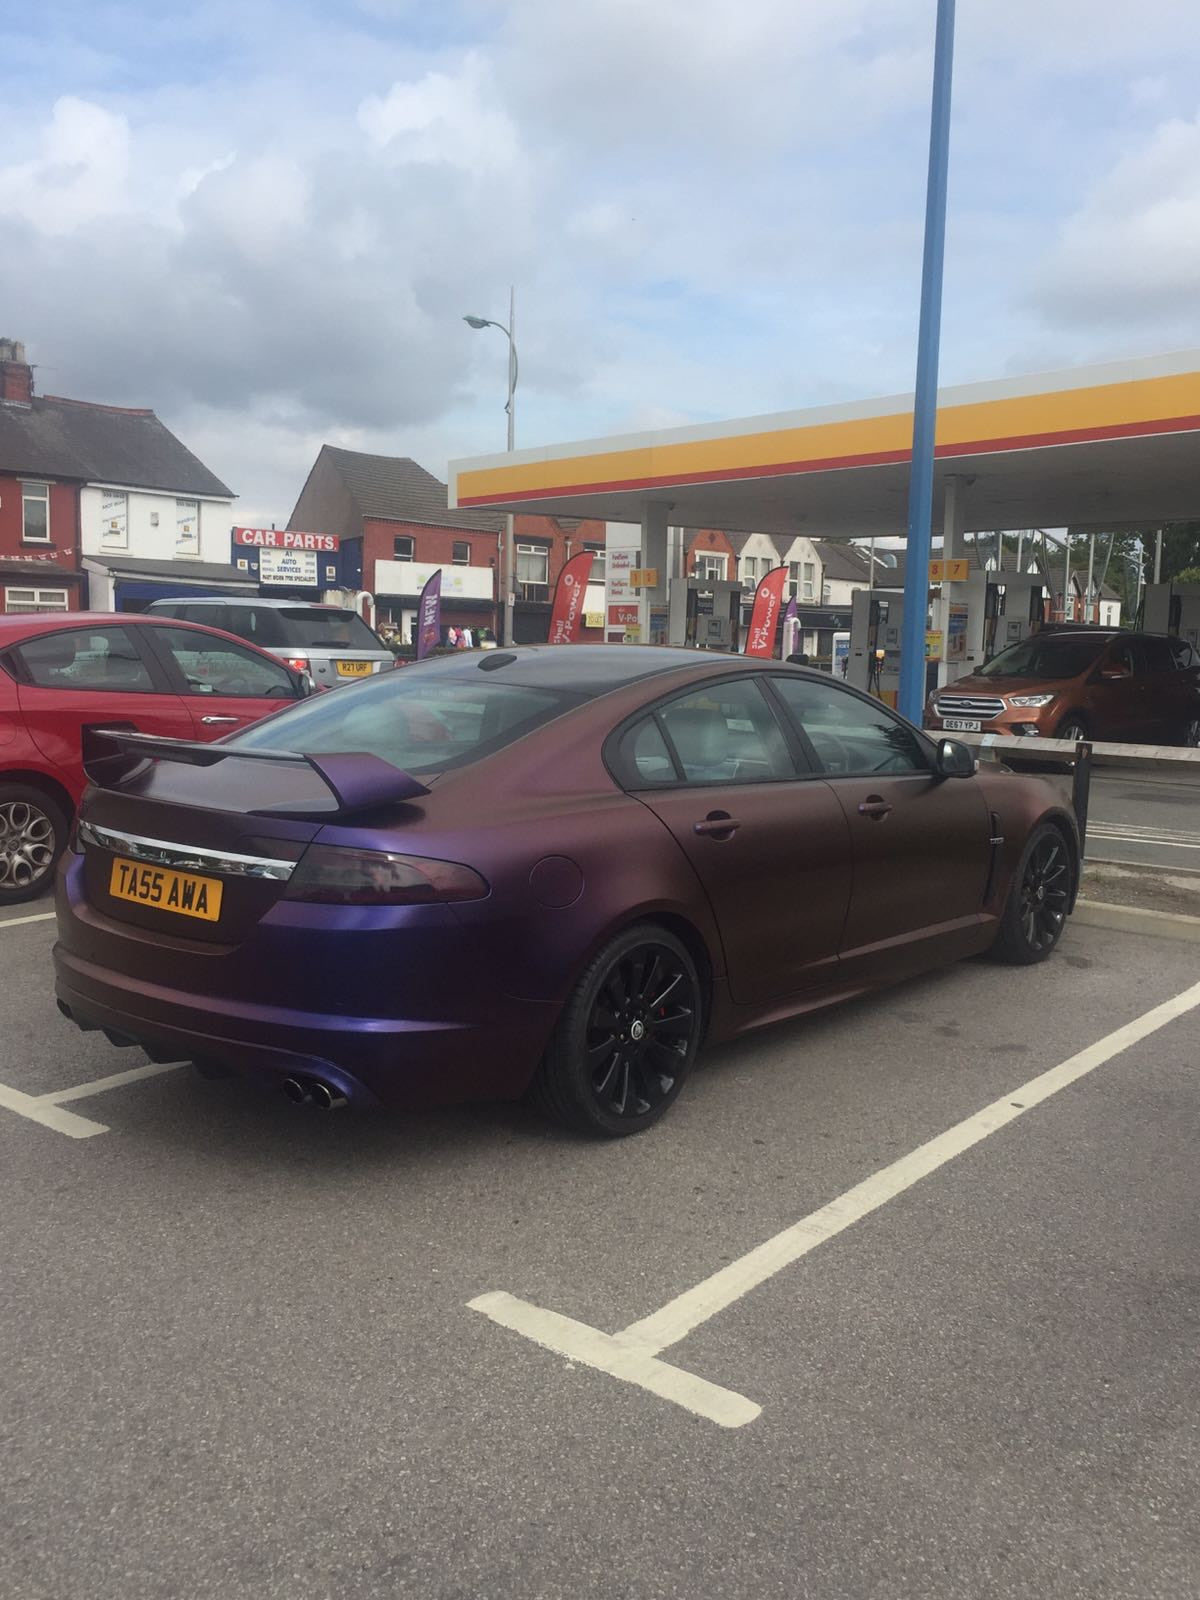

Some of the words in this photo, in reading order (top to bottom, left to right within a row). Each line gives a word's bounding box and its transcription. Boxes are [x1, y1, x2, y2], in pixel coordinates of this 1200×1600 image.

[953, 564, 961, 575] 7
[618, 613, 638, 624] V-Po
[758, 593, 776, 650] V-Power
[752, 627, 761, 650] Shell
[342, 663, 354, 672] R27
[167, 877, 208, 914] AWA
